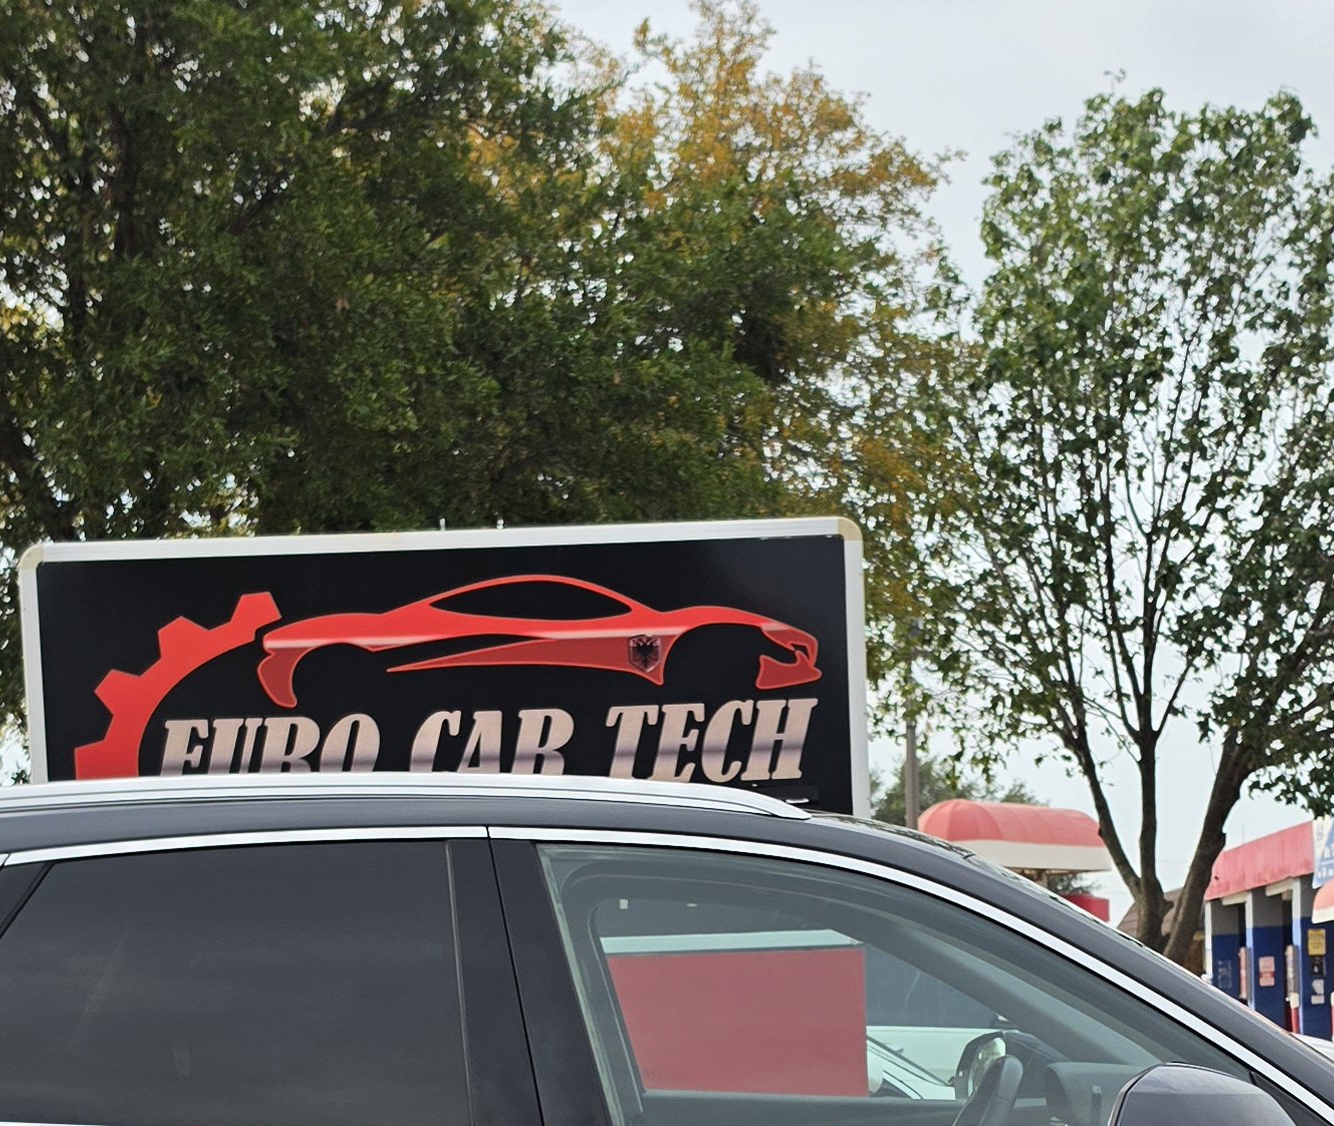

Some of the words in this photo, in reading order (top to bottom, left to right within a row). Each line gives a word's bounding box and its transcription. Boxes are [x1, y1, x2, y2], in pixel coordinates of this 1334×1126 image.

[161, 712, 382, 777] EURO
[411, 706, 575, 776] CAR
[605, 697, 819, 784] TECH
